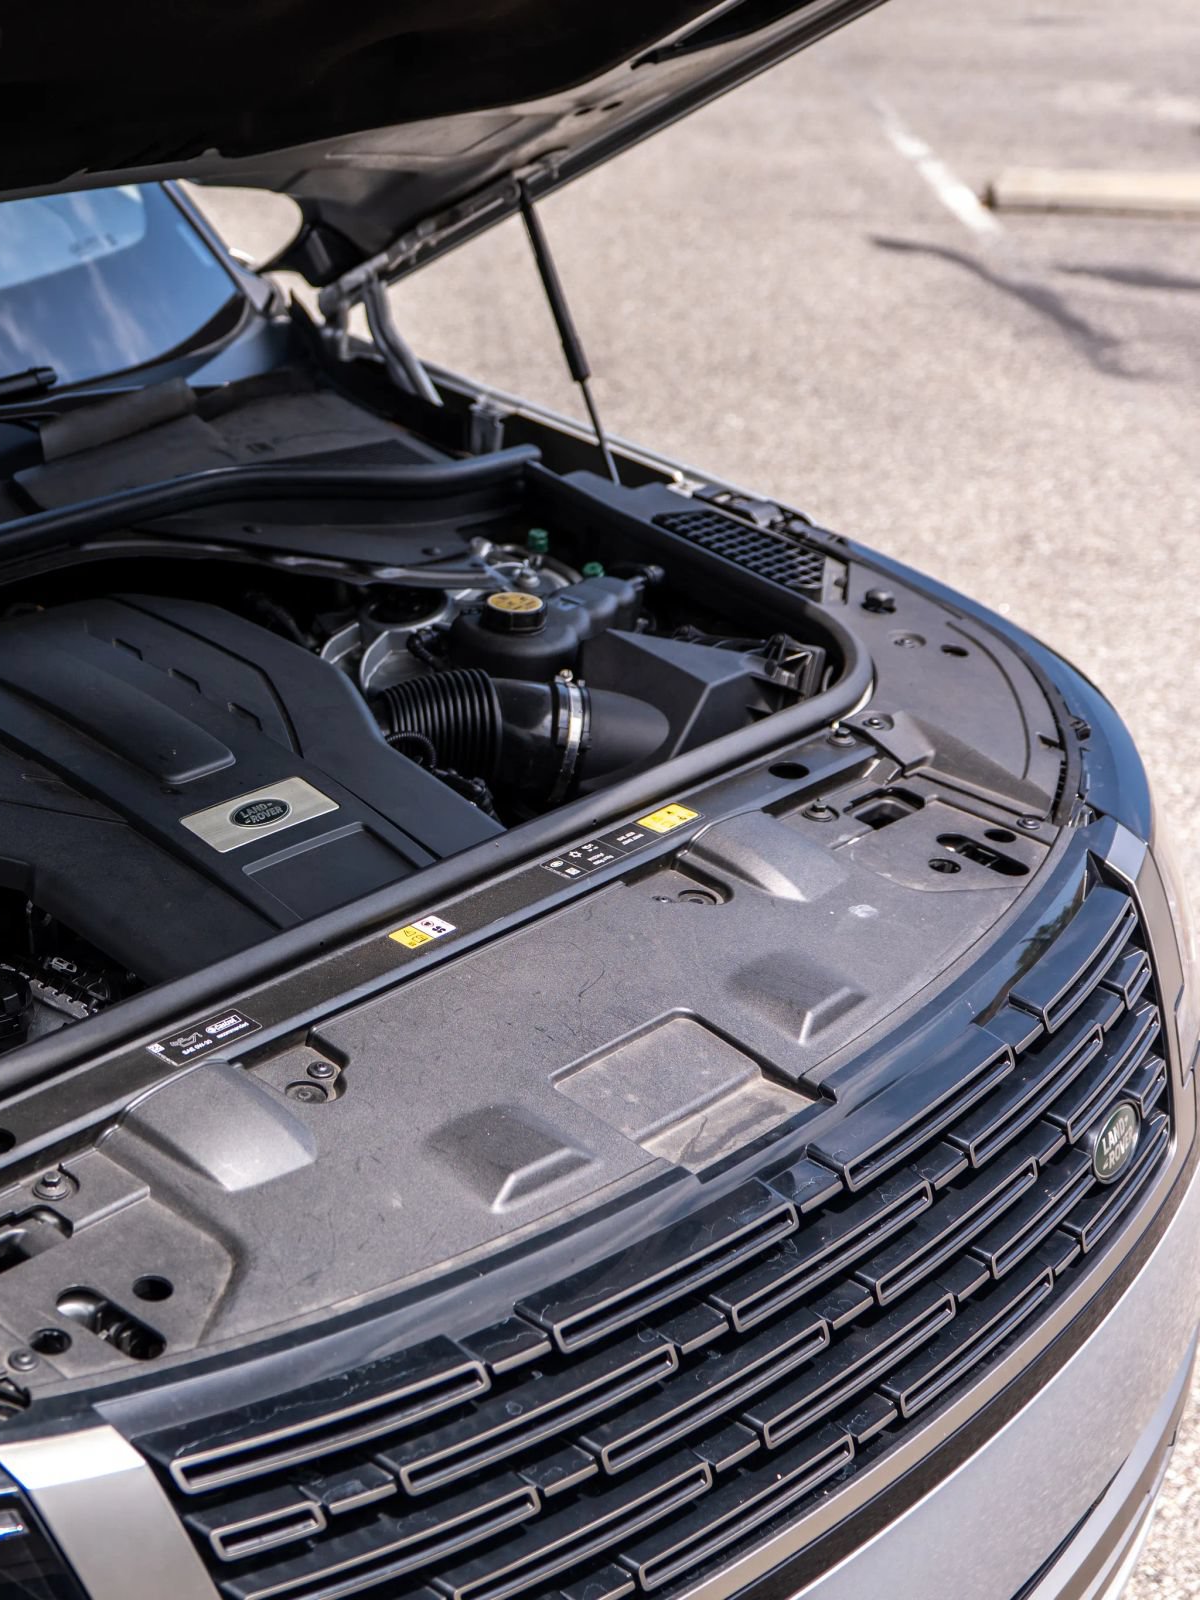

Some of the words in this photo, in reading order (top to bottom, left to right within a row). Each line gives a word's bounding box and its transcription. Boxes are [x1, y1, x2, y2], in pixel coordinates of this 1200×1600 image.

[240, 803, 267, 818] LAND
[251, 806, 284, 823] ROVER
[1102, 1118, 1126, 1155] LAND
[1109, 1125, 1135, 1169] ROVER
